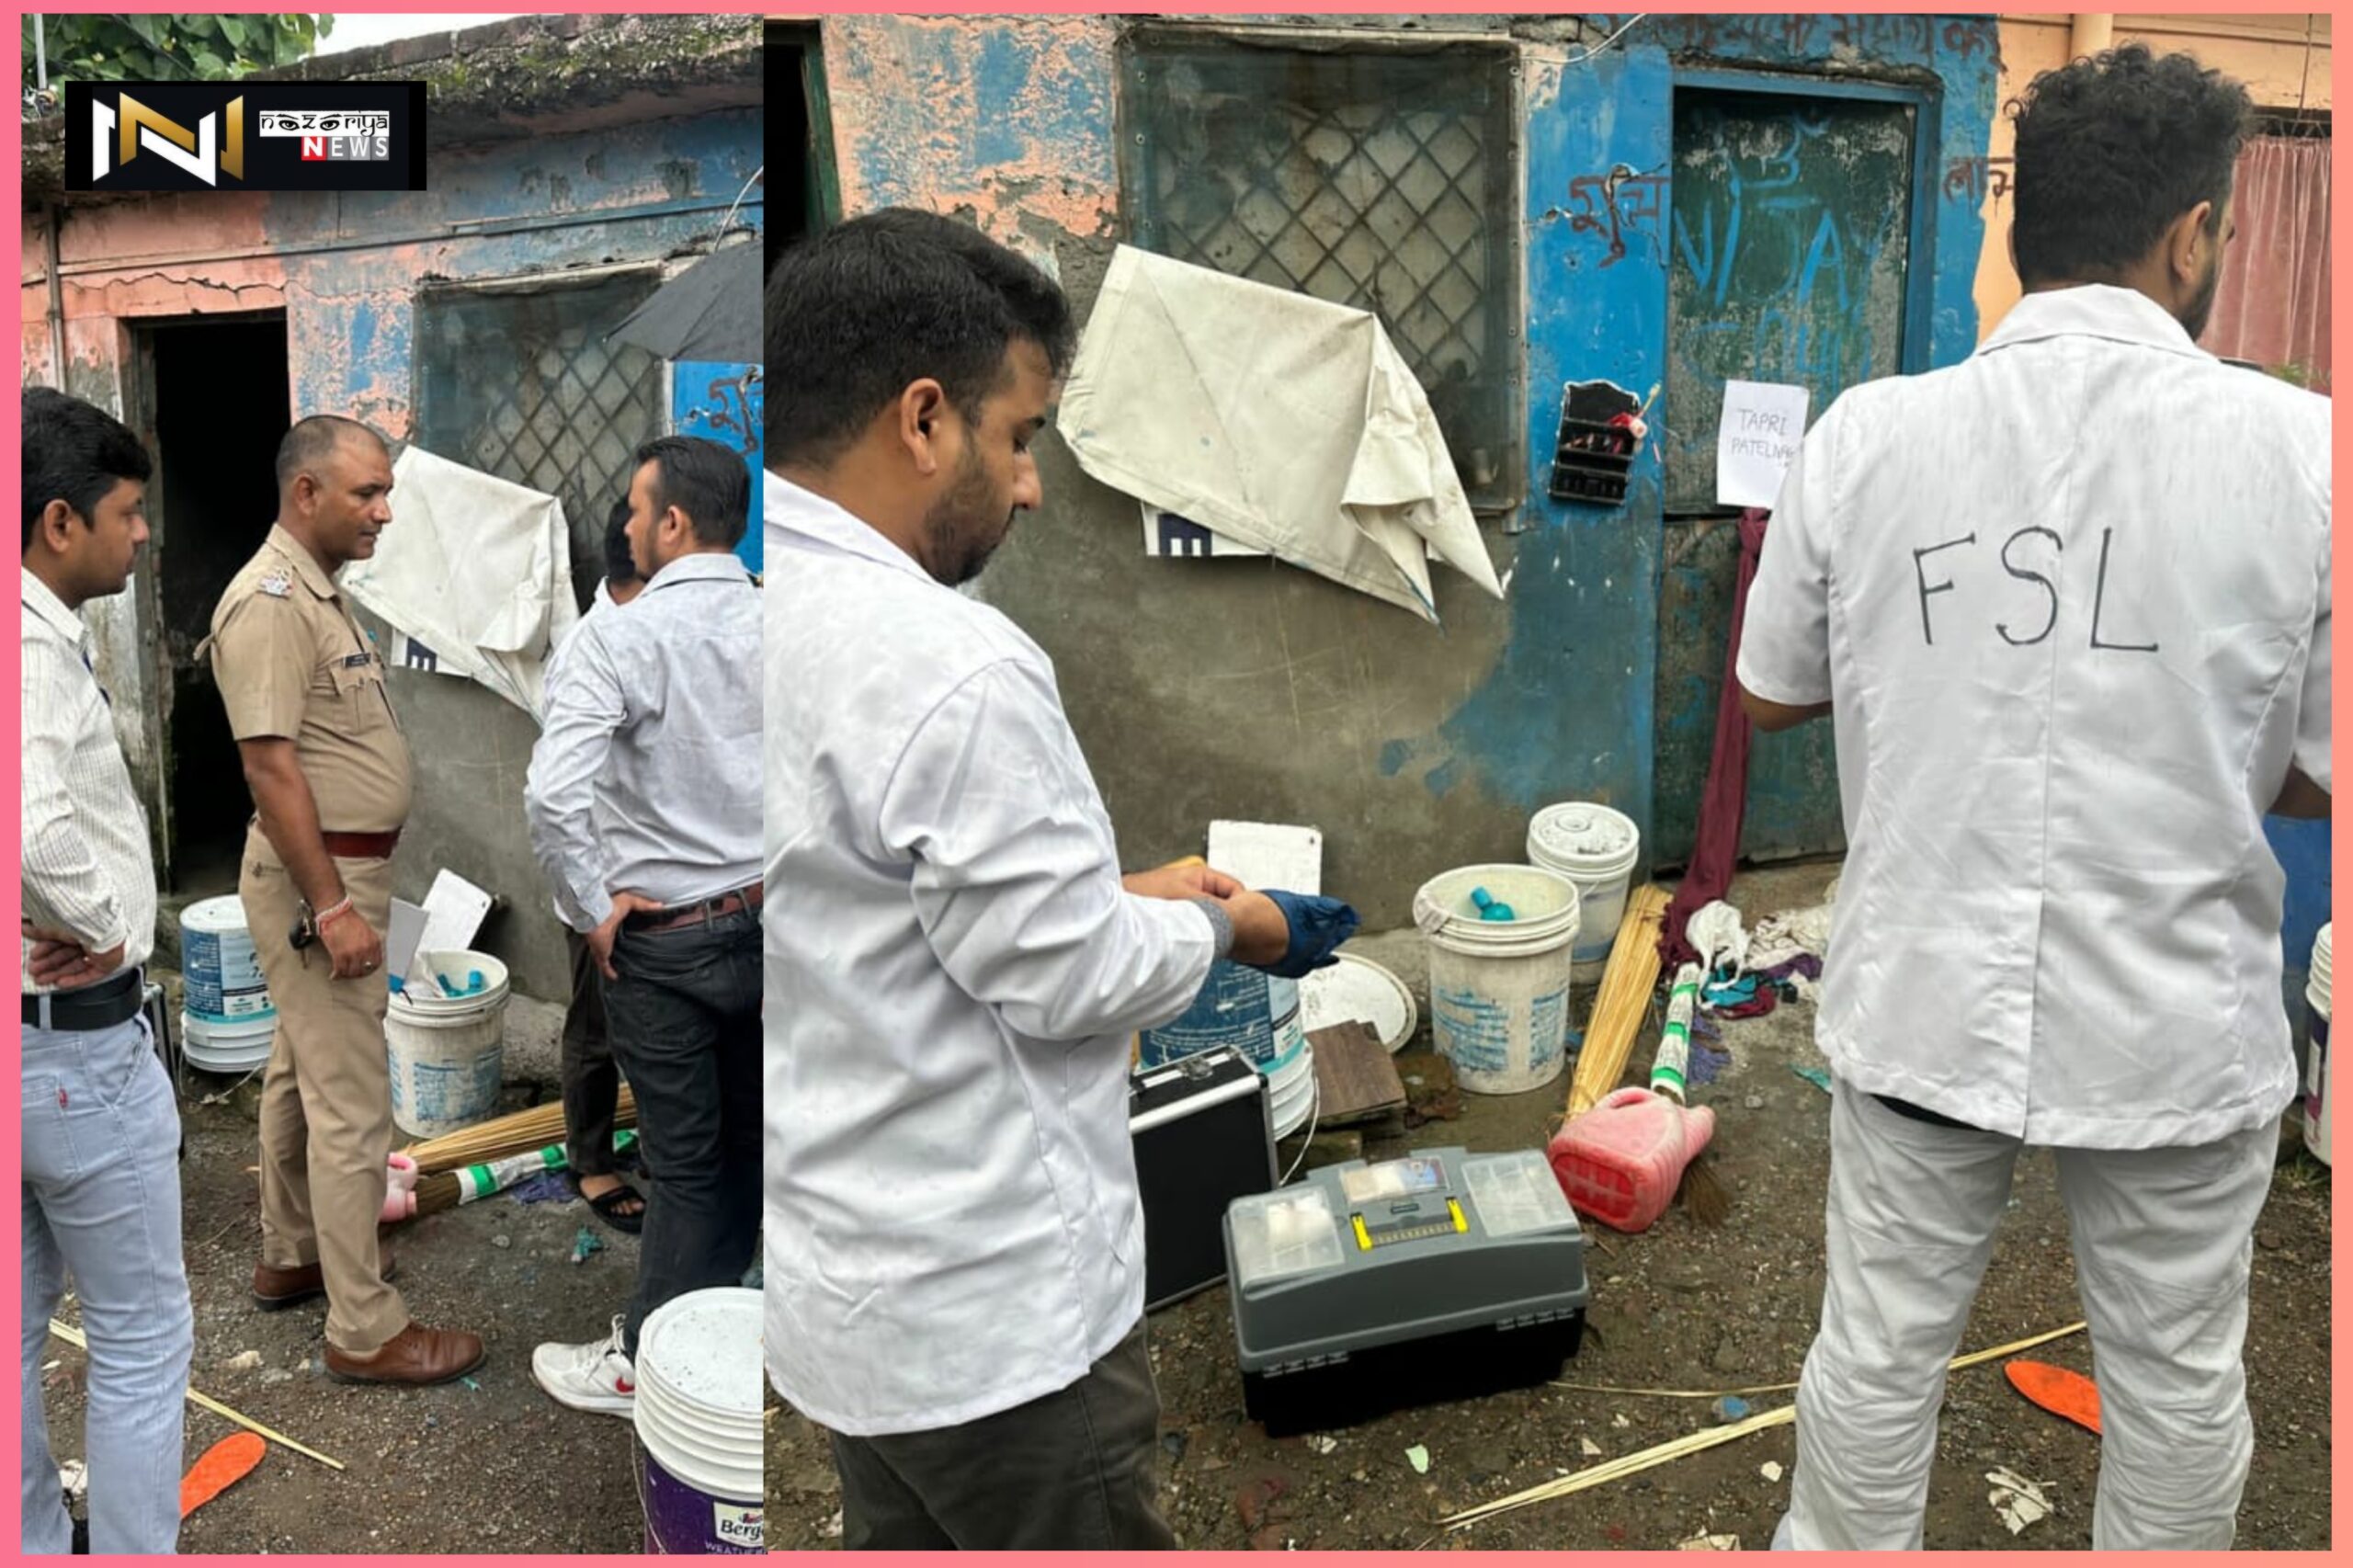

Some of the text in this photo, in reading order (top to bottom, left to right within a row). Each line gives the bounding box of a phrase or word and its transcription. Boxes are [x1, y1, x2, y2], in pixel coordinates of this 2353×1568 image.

[1736, 407, 1788, 437] TAPRI
[1913, 525, 2159, 653] FSL
[721, 1518, 764, 1541] Berg
